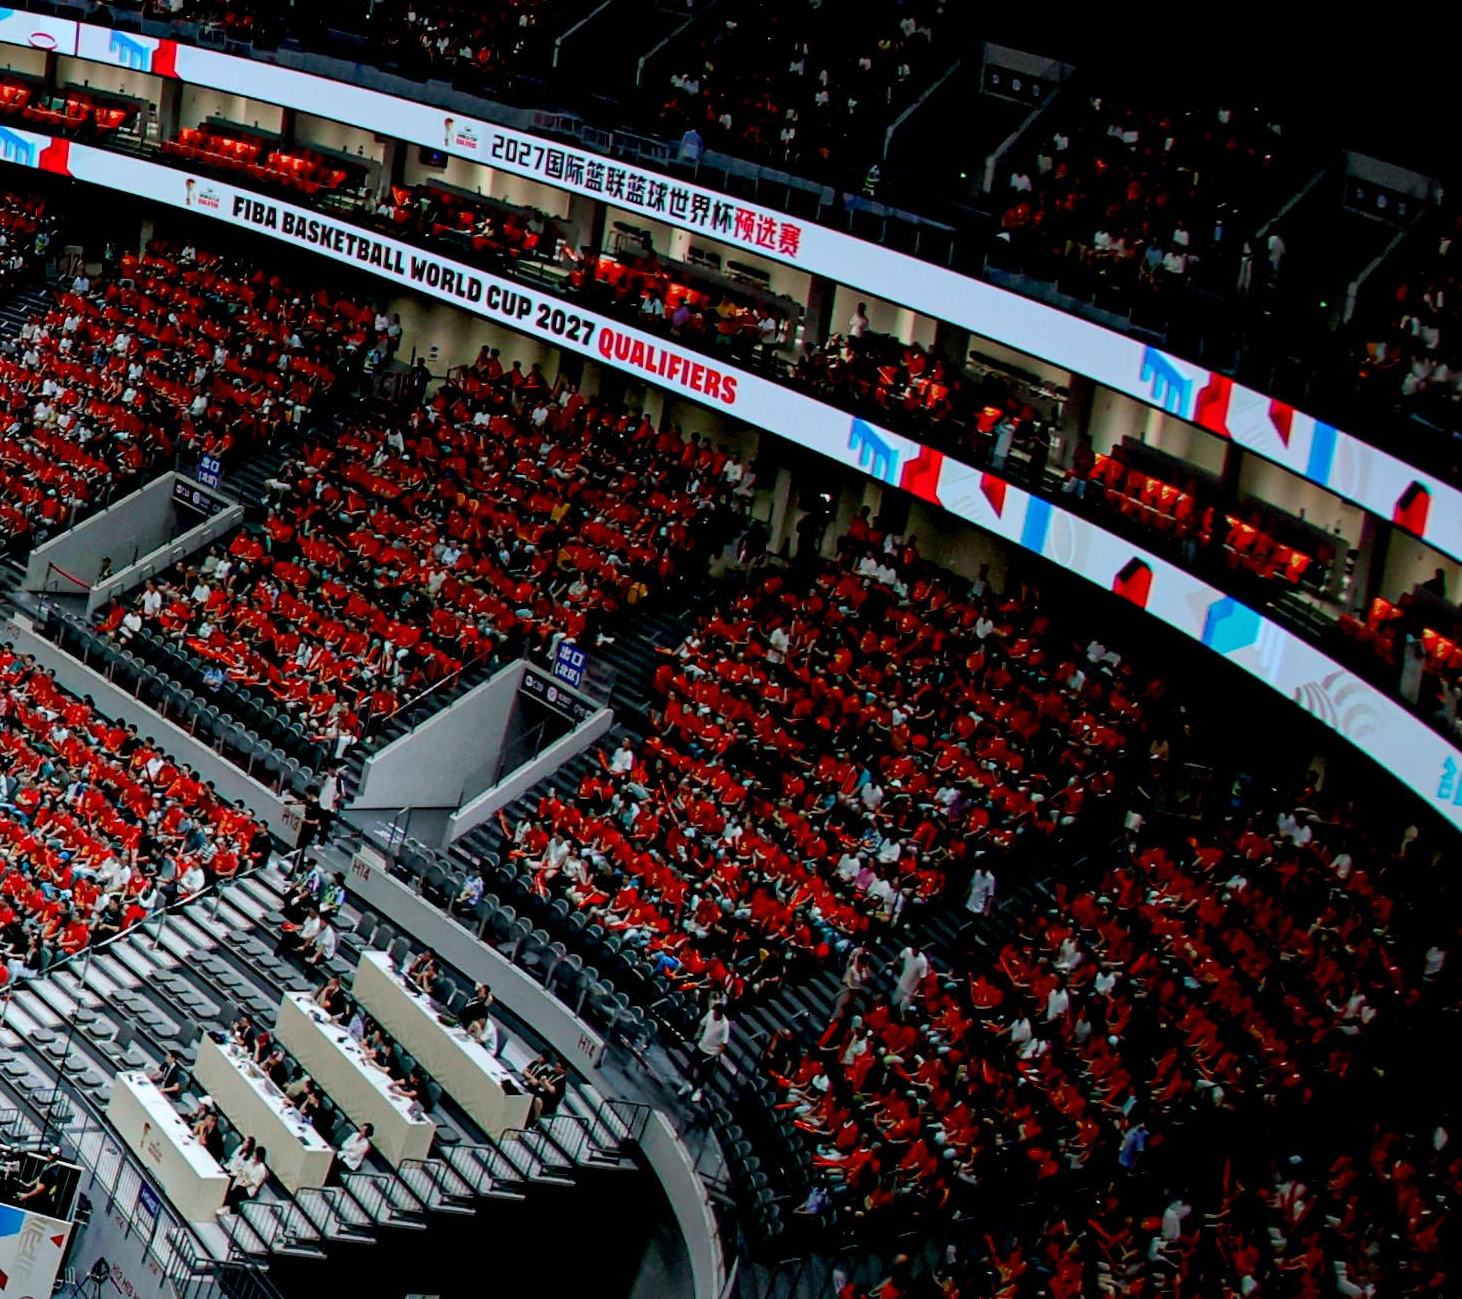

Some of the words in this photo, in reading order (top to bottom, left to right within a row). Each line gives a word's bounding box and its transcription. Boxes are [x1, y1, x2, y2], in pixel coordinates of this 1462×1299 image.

[491, 133, 802, 259] 2027国际篮联篮球世界杯预选赛
[232, 195, 277, 228] FIBA
[282, 212, 406, 275] BASKETBALL
[411, 255, 481, 303] WORLD
[485, 285, 532, 321] CUP
[535, 303, 596, 347] 2027
[598, 326, 738, 405] QUALIFIERS
[200, 458, 221, 473] 出口
[559, 644, 585, 668] 出口
